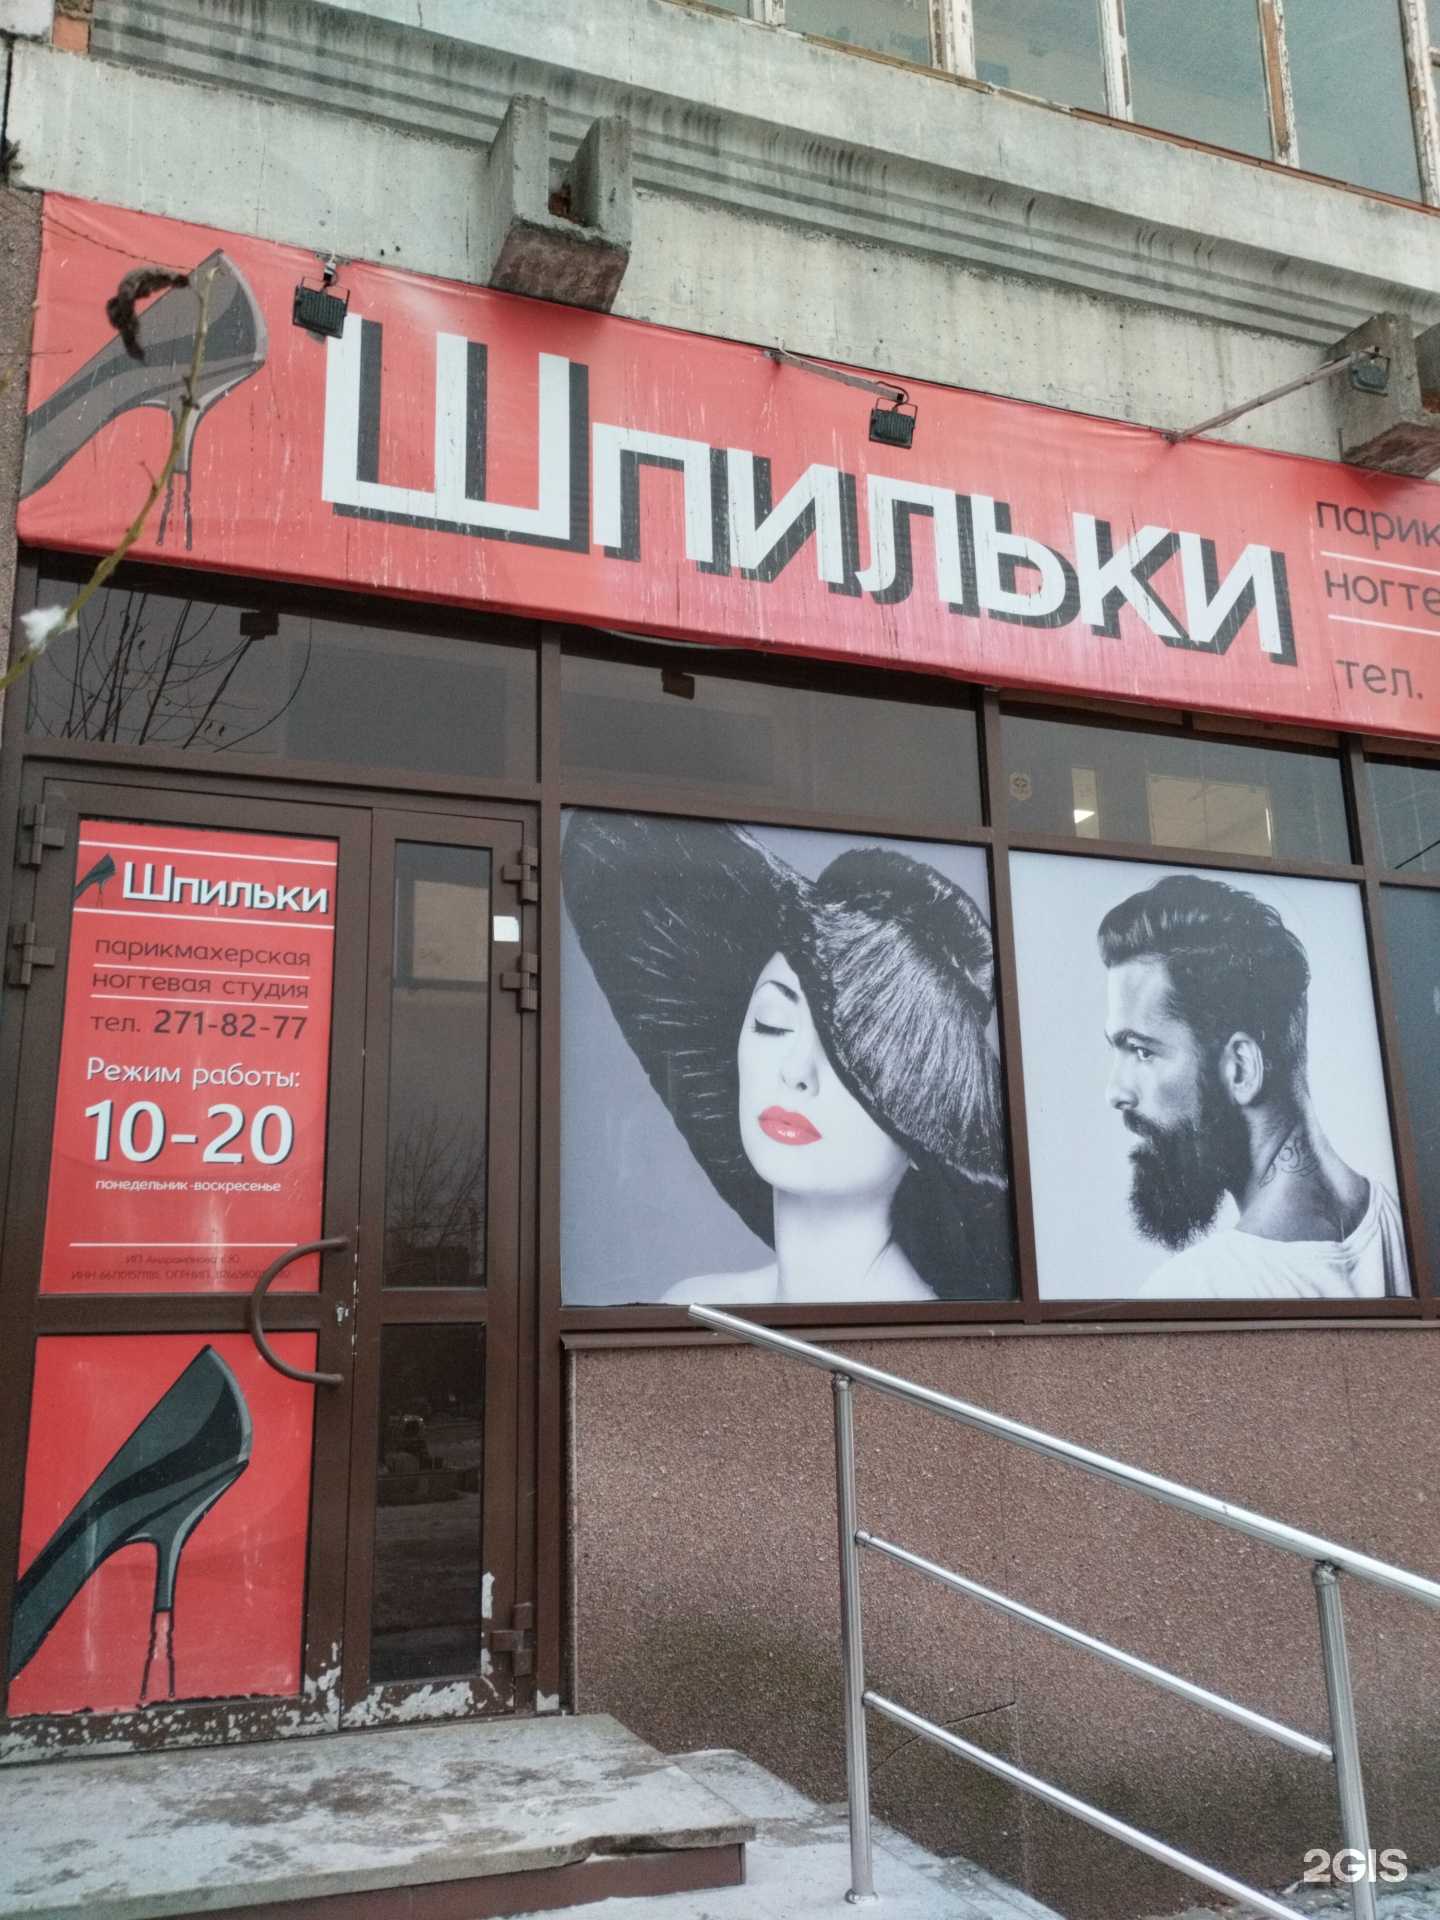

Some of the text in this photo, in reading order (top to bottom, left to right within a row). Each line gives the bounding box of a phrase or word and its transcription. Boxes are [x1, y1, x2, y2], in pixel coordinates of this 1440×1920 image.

[321, 312, 1298, 667] Шпильки
[1316, 501, 1440, 550] парик
[1324, 569, 1440, 616] ногте
[1336, 659, 1423, 700] тел.
[122, 861, 329, 914] Шпильки
[95, 938, 311, 967] парикмахерская
[91, 972, 309, 1000] ногтевая студия
[90, 1009, 308, 1039] тел. 271-82-77
[86, 1056, 302, 1091] Режим работы:
[85, 1099, 295, 1166] 10-20
